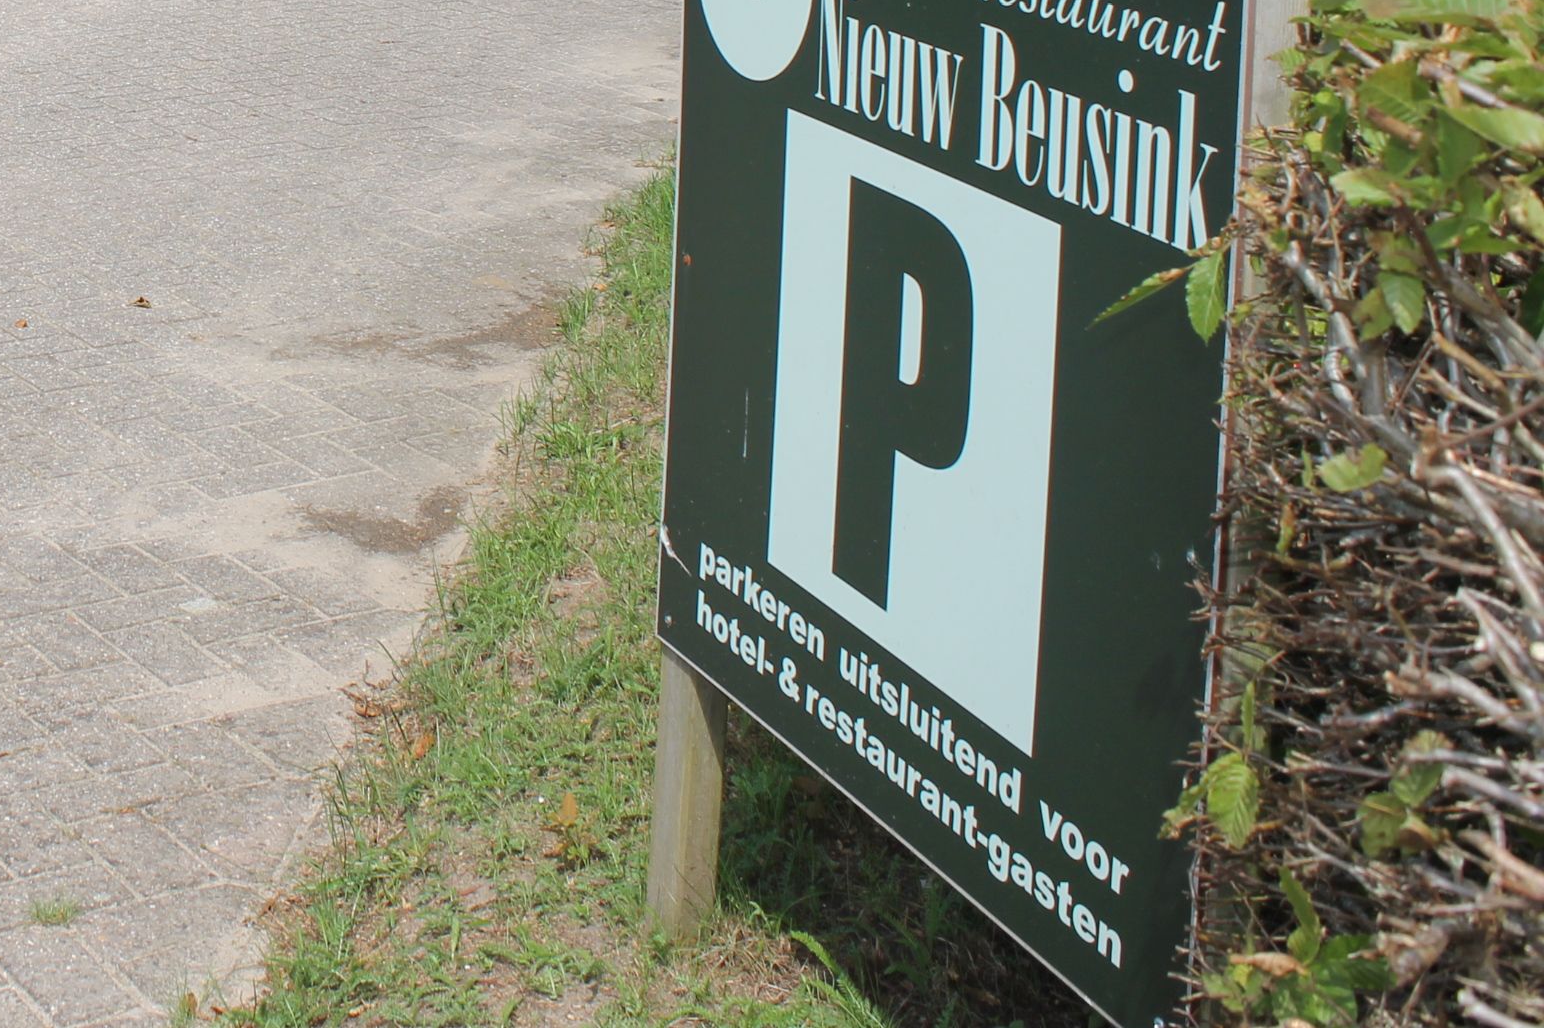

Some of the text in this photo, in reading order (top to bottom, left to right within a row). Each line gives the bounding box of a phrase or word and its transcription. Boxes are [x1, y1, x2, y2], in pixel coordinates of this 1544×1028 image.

[974, 22, 1219, 251] Beusink
[832, 174, 974, 613] P
[696, 590, 1122, 969] hotel- & restaurant-gasten
[699, 541, 1130, 895] parkeren uitsluitend voor
